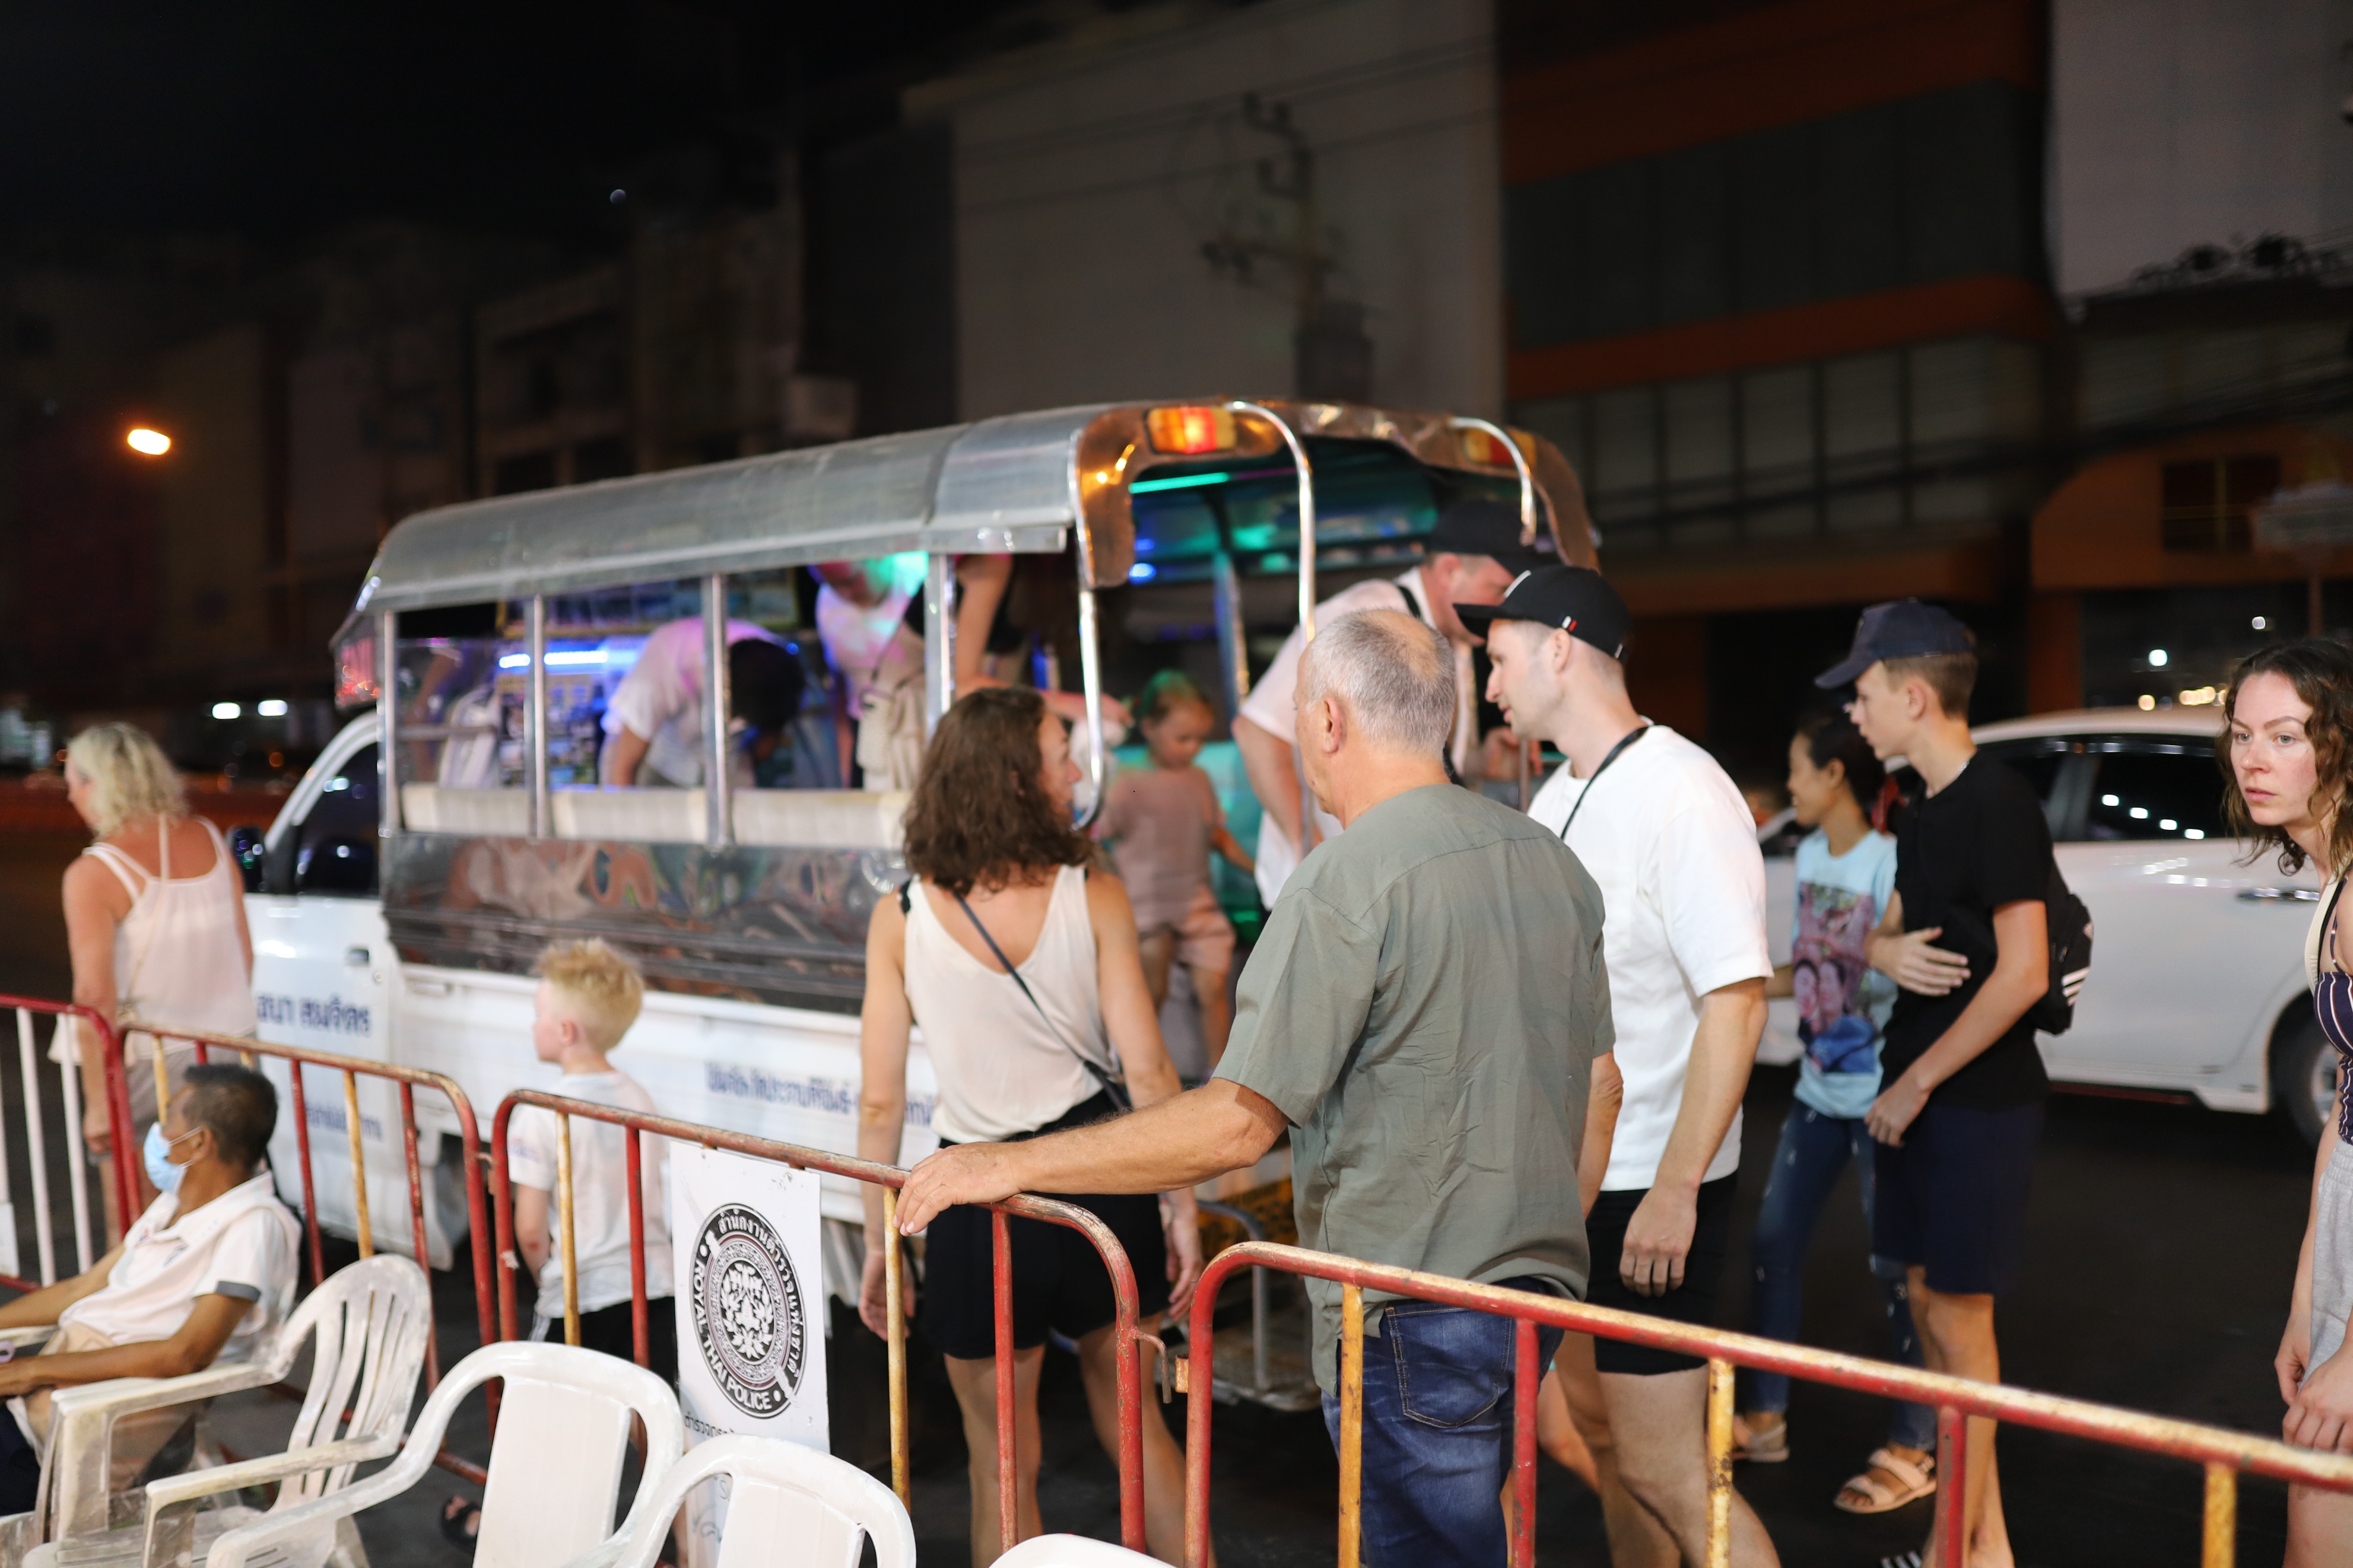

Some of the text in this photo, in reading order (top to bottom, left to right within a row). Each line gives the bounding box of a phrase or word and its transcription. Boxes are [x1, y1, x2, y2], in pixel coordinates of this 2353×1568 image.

[693, 1260, 773, 1411] ROYAL THAI POLICE
[718, 1208, 802, 1377] สำนักงานตำรวจแห่งชาติ
